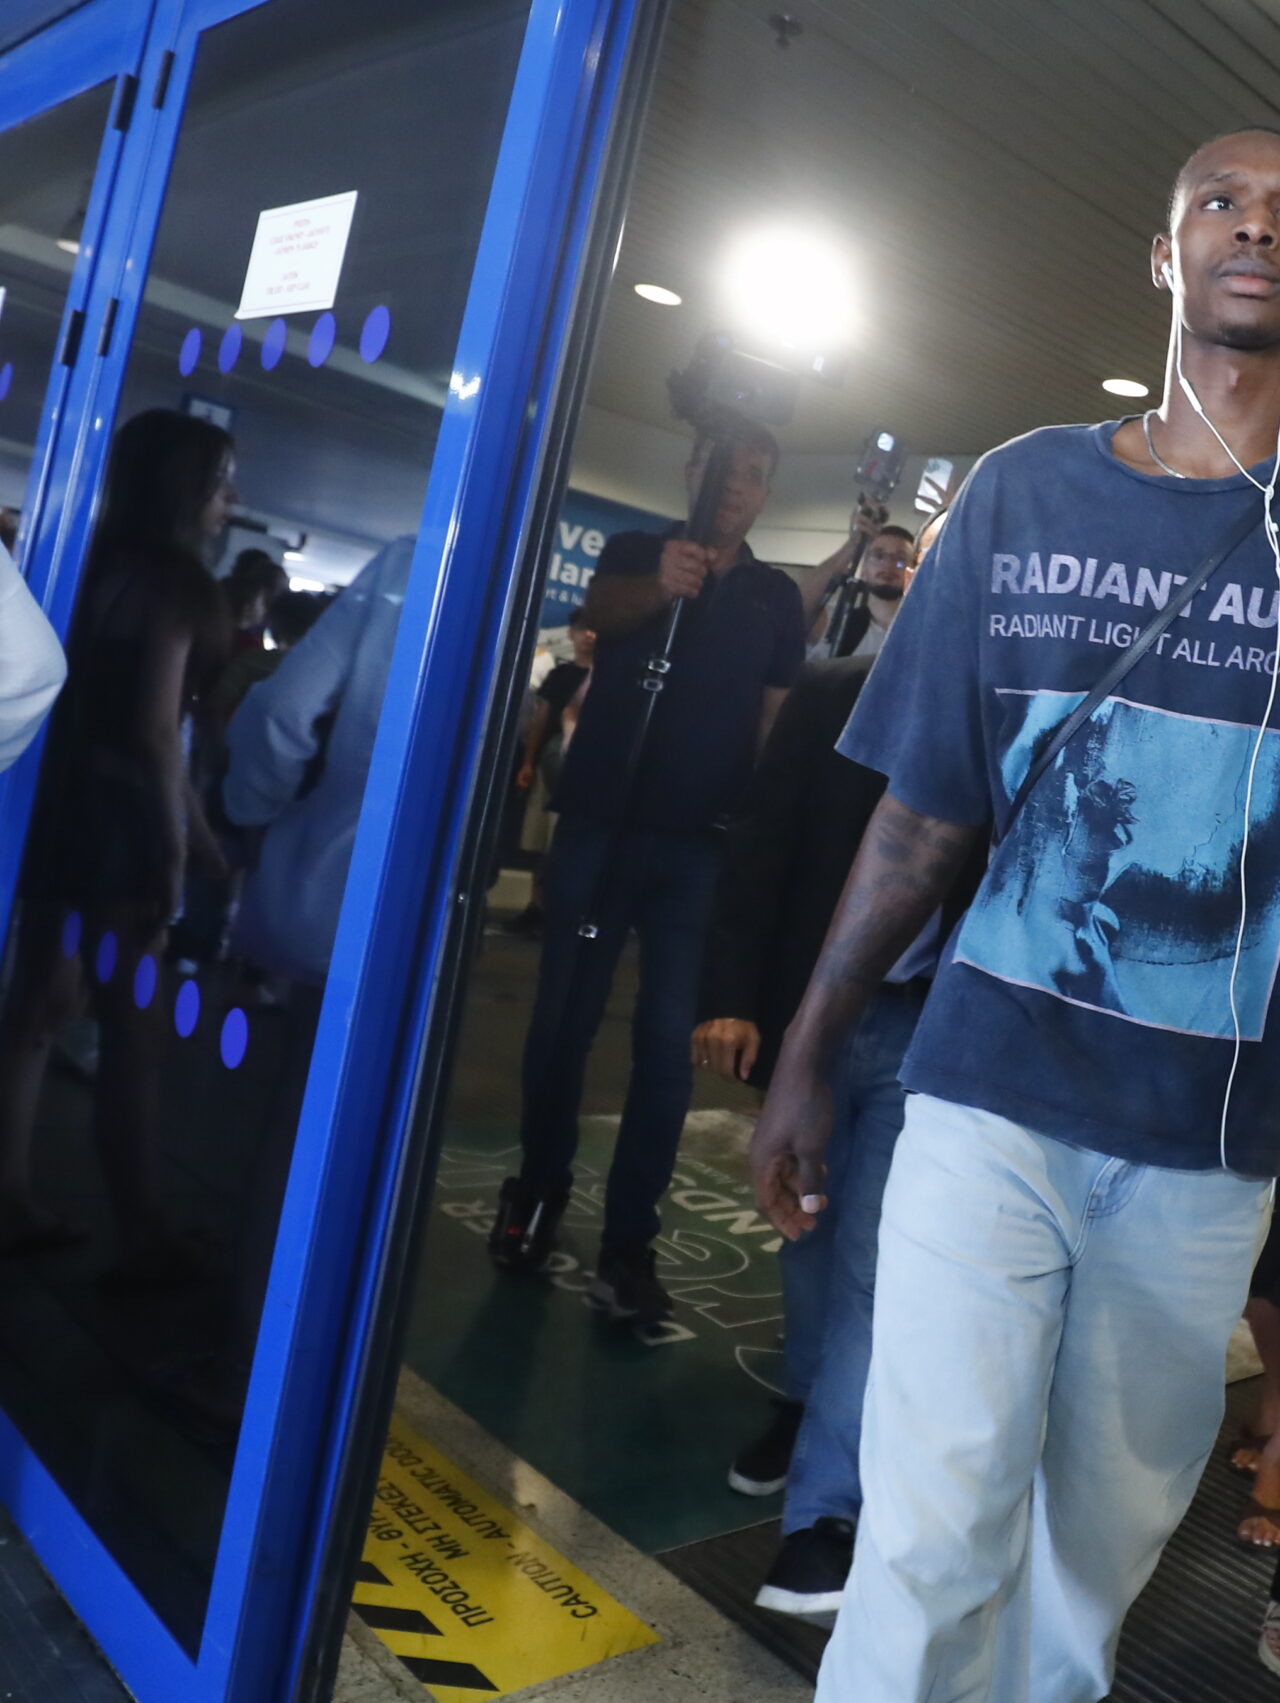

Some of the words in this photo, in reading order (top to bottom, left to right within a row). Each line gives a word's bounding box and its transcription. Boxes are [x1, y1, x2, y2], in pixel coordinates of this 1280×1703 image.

[559, 521, 605, 557] ve
[989, 614, 1086, 640] RADIANT
[1172, 638, 1220, 667] ALL
[410, 1466, 512, 1540] AUTOMATIC
[426, 1533, 470, 1560] ΜΗ
[398, 1551, 495, 1628] ΠΡΟΣΟΧΗ
[507, 1550, 598, 1619] CAUTION
